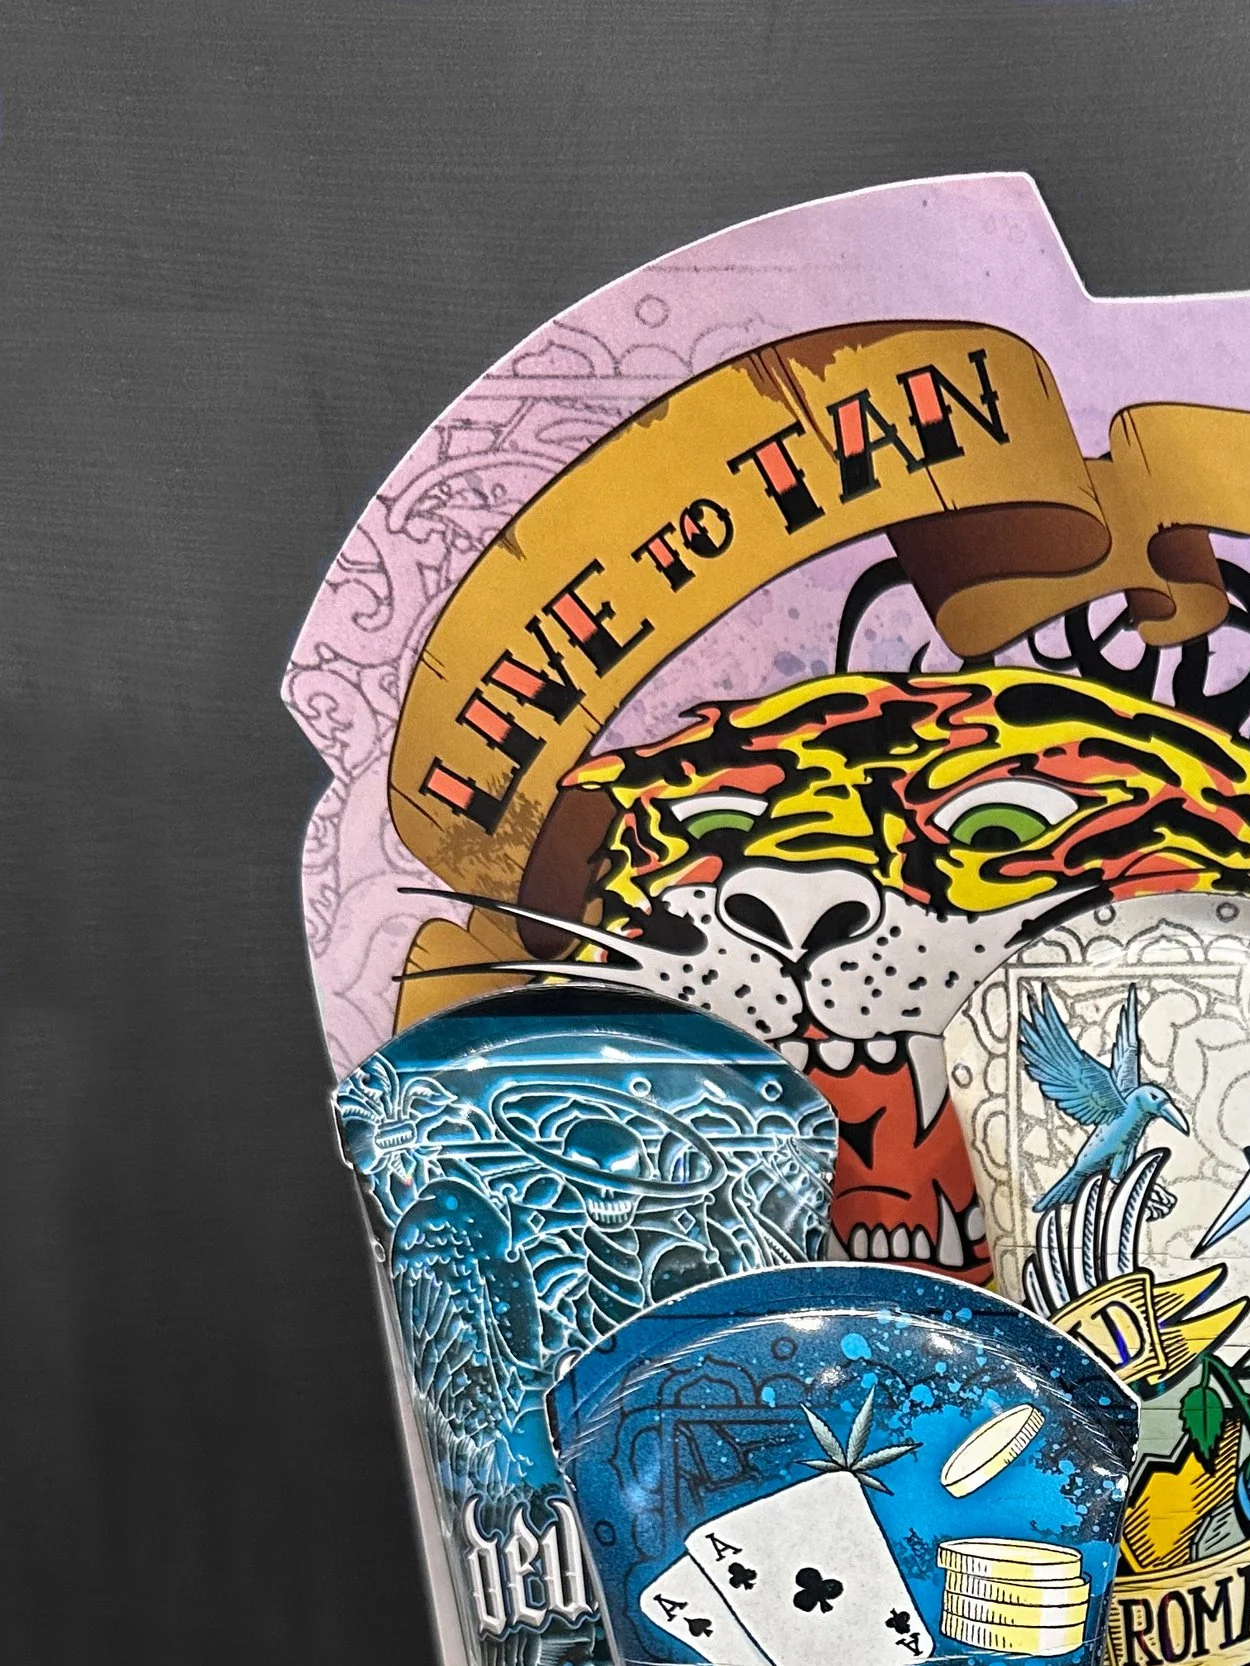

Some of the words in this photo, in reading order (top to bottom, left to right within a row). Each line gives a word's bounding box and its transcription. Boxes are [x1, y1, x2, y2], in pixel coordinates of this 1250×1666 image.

[417, 559, 655, 835] LIVE
[631, 498, 734, 592] TO
[727, 348, 1010, 535] TAN
[705, 1533, 742, 1561] A
[653, 1594, 688, 1621] A
